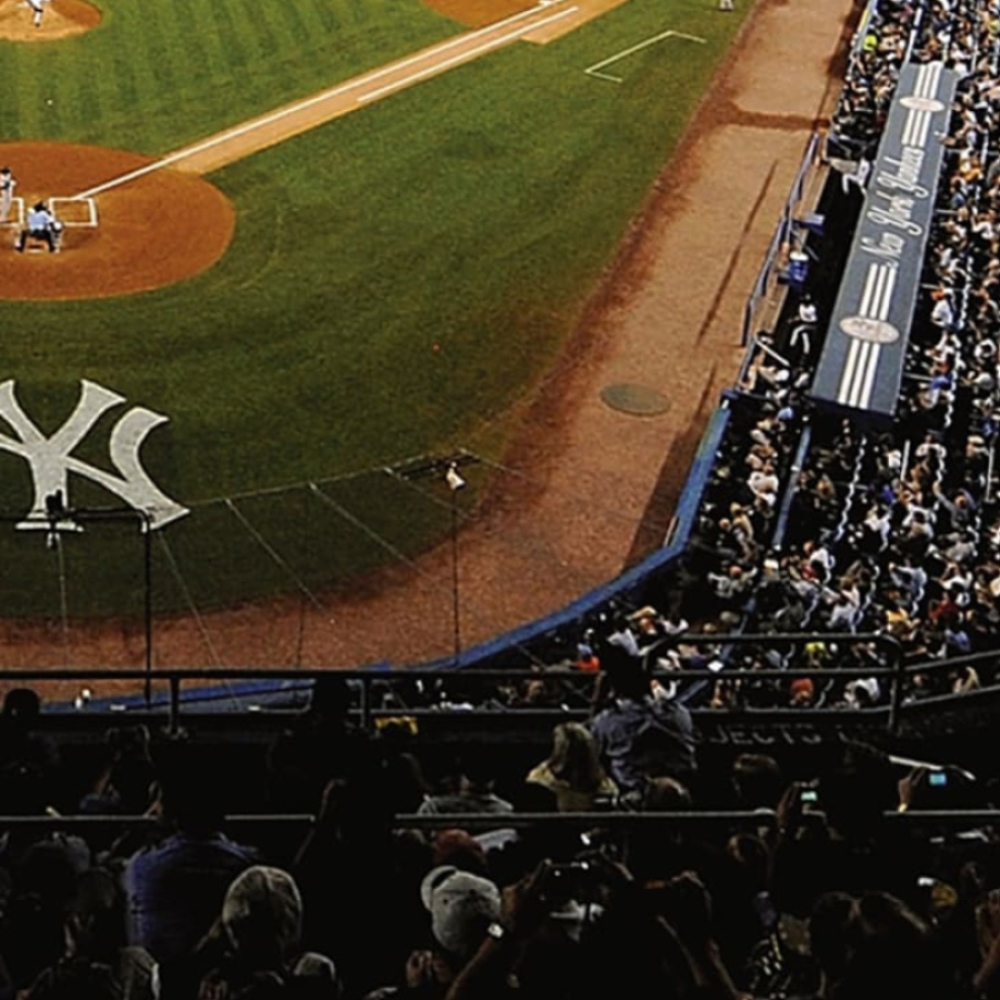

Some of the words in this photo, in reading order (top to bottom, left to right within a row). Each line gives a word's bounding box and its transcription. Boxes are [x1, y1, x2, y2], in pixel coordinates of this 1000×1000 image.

[877, 146, 929, 198] Yankees
[867, 191, 923, 236] York
[860, 231, 905, 268] New
